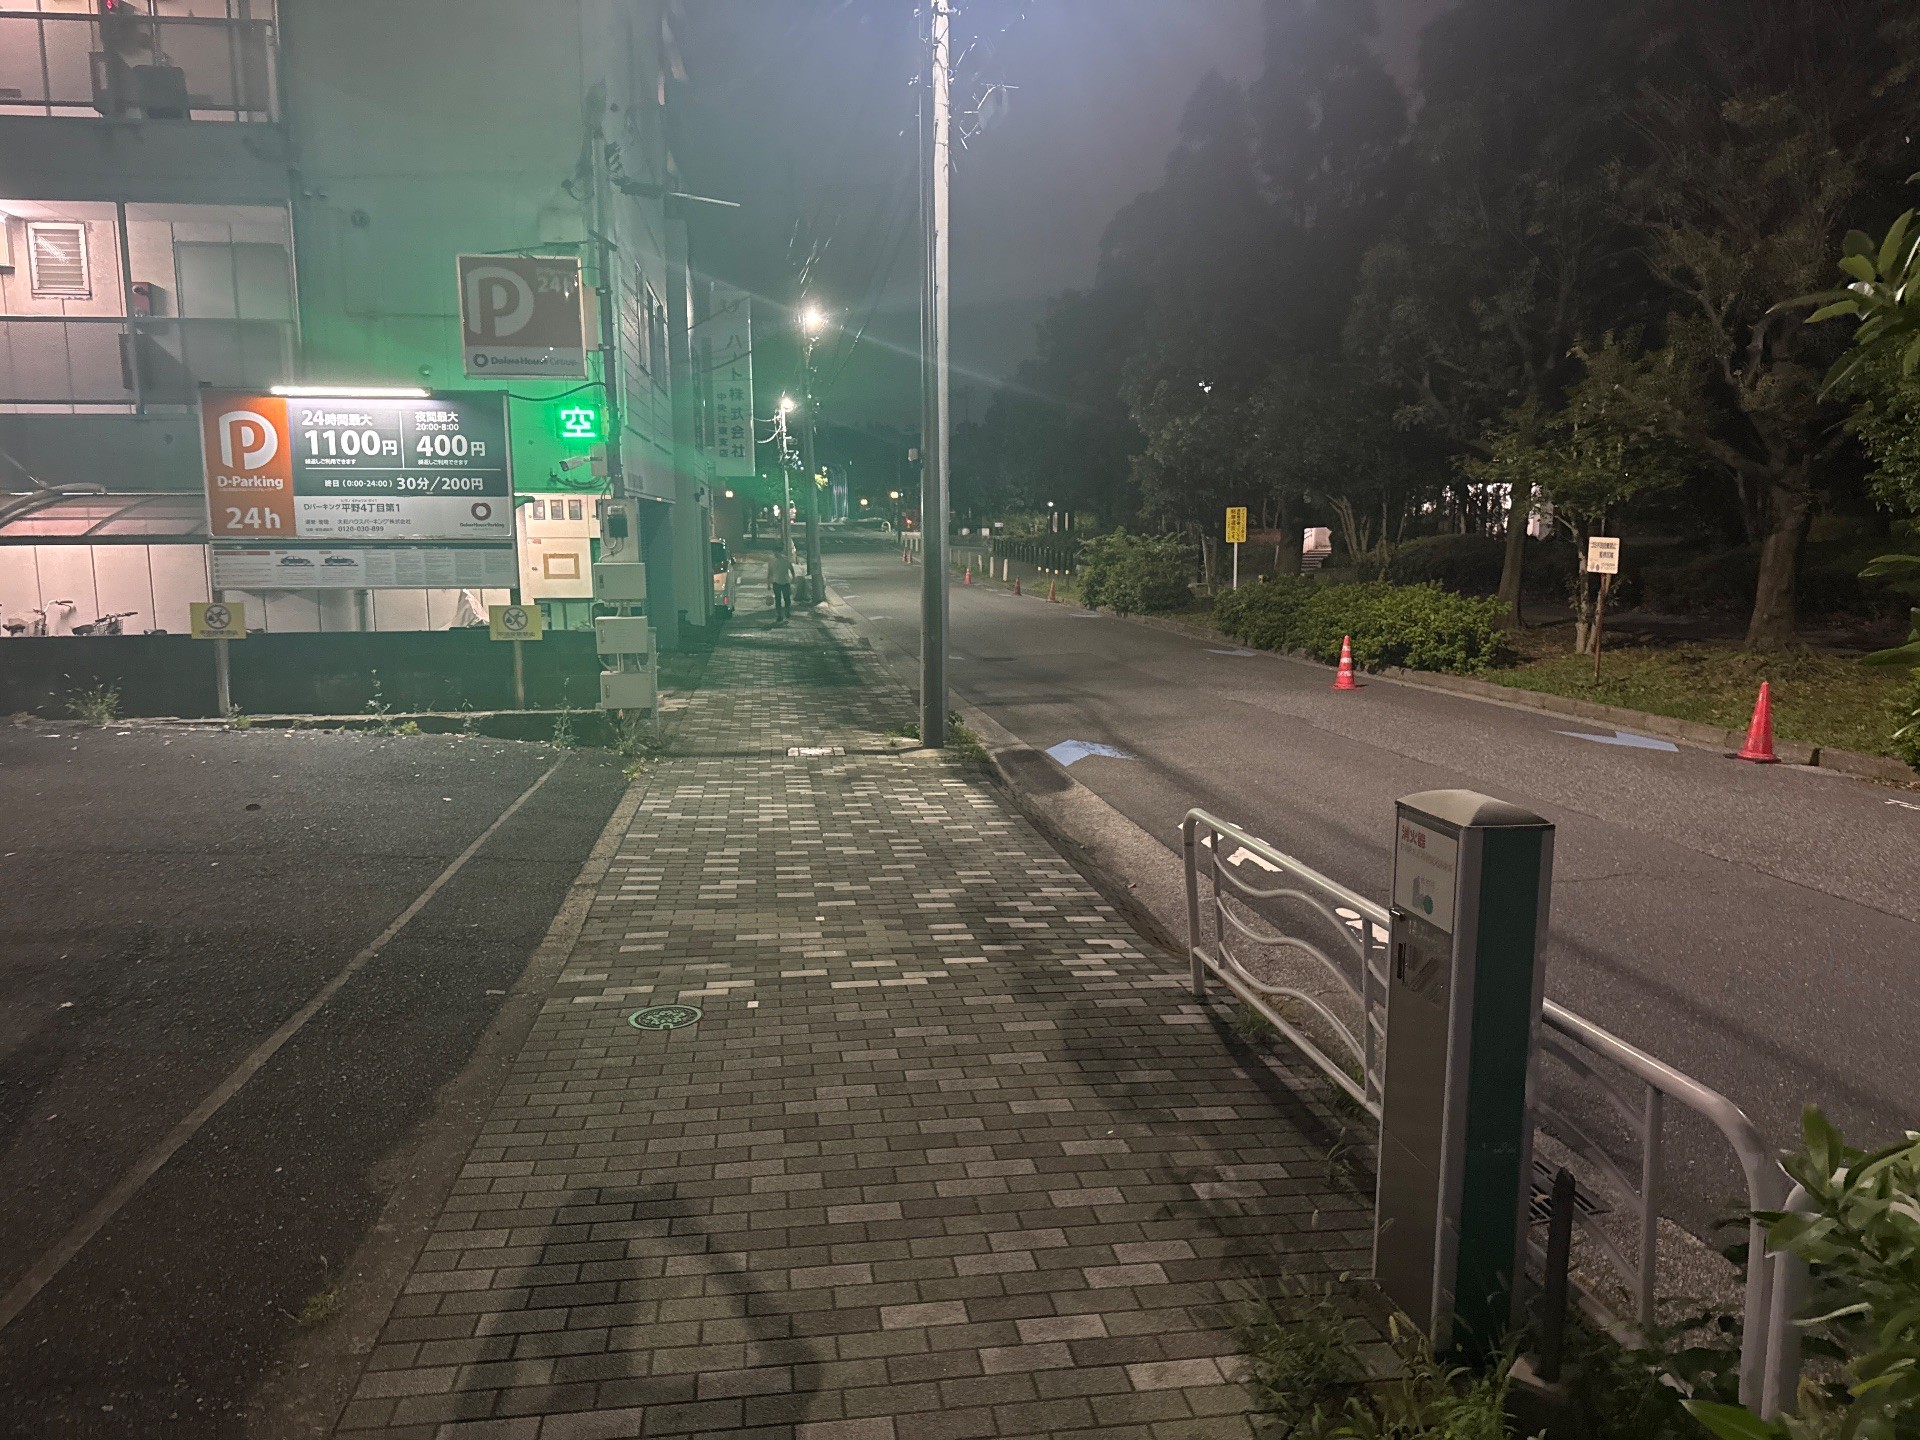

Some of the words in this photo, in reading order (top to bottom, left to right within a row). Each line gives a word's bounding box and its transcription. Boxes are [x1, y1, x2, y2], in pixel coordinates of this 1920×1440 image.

[301, 409, 373, 426] 24時間最大
[414, 411, 459, 423] 夜間最大
[415, 423, 460, 432] 20:00-8:00
[560, 406, 597, 439] 空
[304, 429, 399, 456] 1100円
[416, 434, 487, 457] 400円
[217, 475, 284, 490] D-Parking
[226, 506, 281, 529] 24h
[1401, 824, 1427, 849] 消火器
